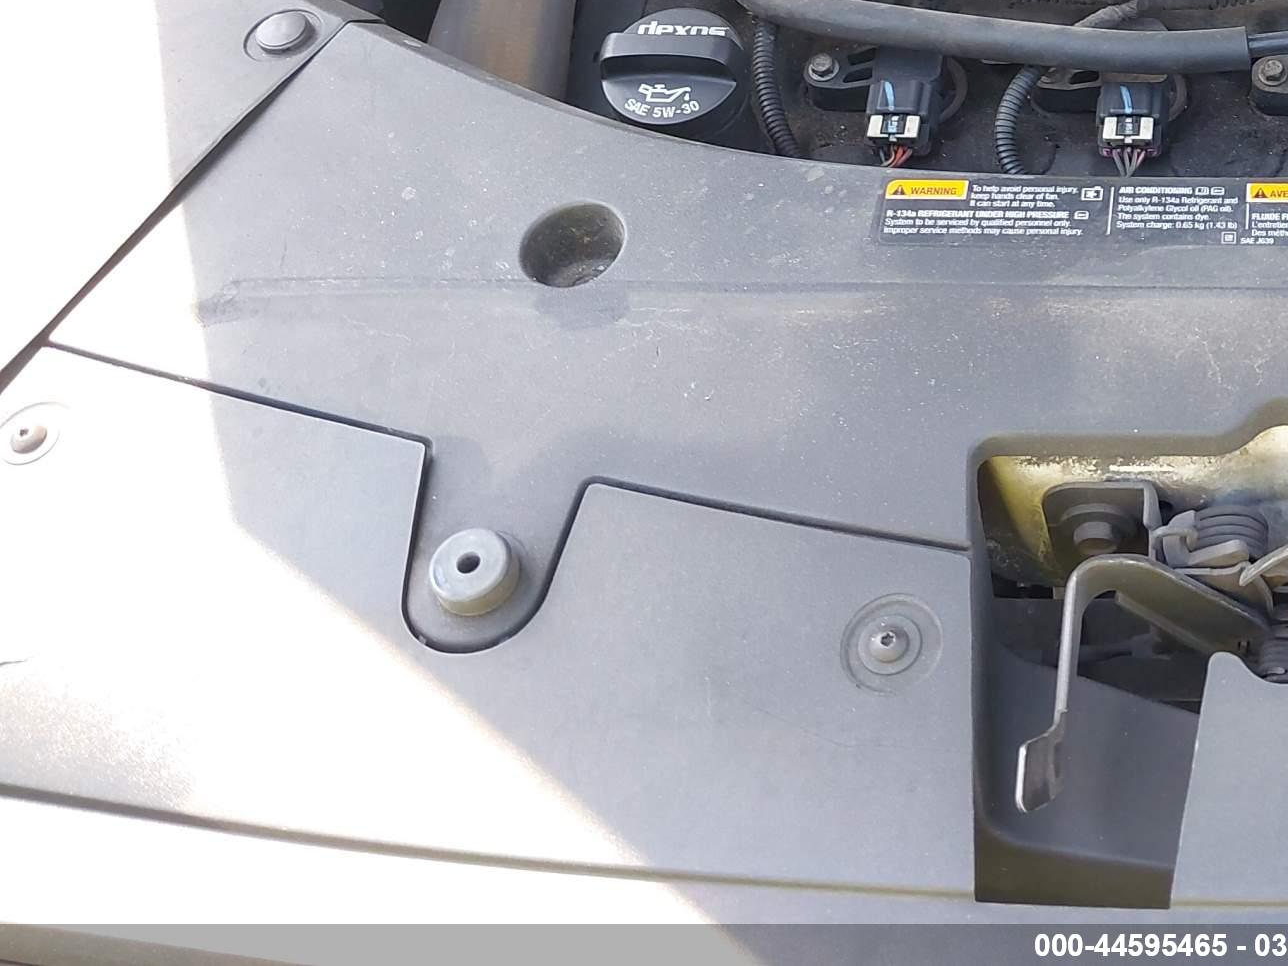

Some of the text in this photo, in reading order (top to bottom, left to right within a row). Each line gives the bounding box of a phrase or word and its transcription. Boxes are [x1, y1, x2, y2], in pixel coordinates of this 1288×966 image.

[624, 98, 700, 118] SAE 5W-30
[910, 186, 957, 194] WARNING
[972, 184, 981, 192] To
[1023, 186, 1055, 194] personal
[1119, 186, 1134, 194] AIR
[1182, 196, 1222, 204] Refrigerant
[918, 210, 974, 218] REFRIGERANT
[975, 210, 1004, 218] UNDER
[1005, 210, 1025, 218] HIGH
[885, 218, 913, 226] System
[1117, 221, 1144, 230] System
